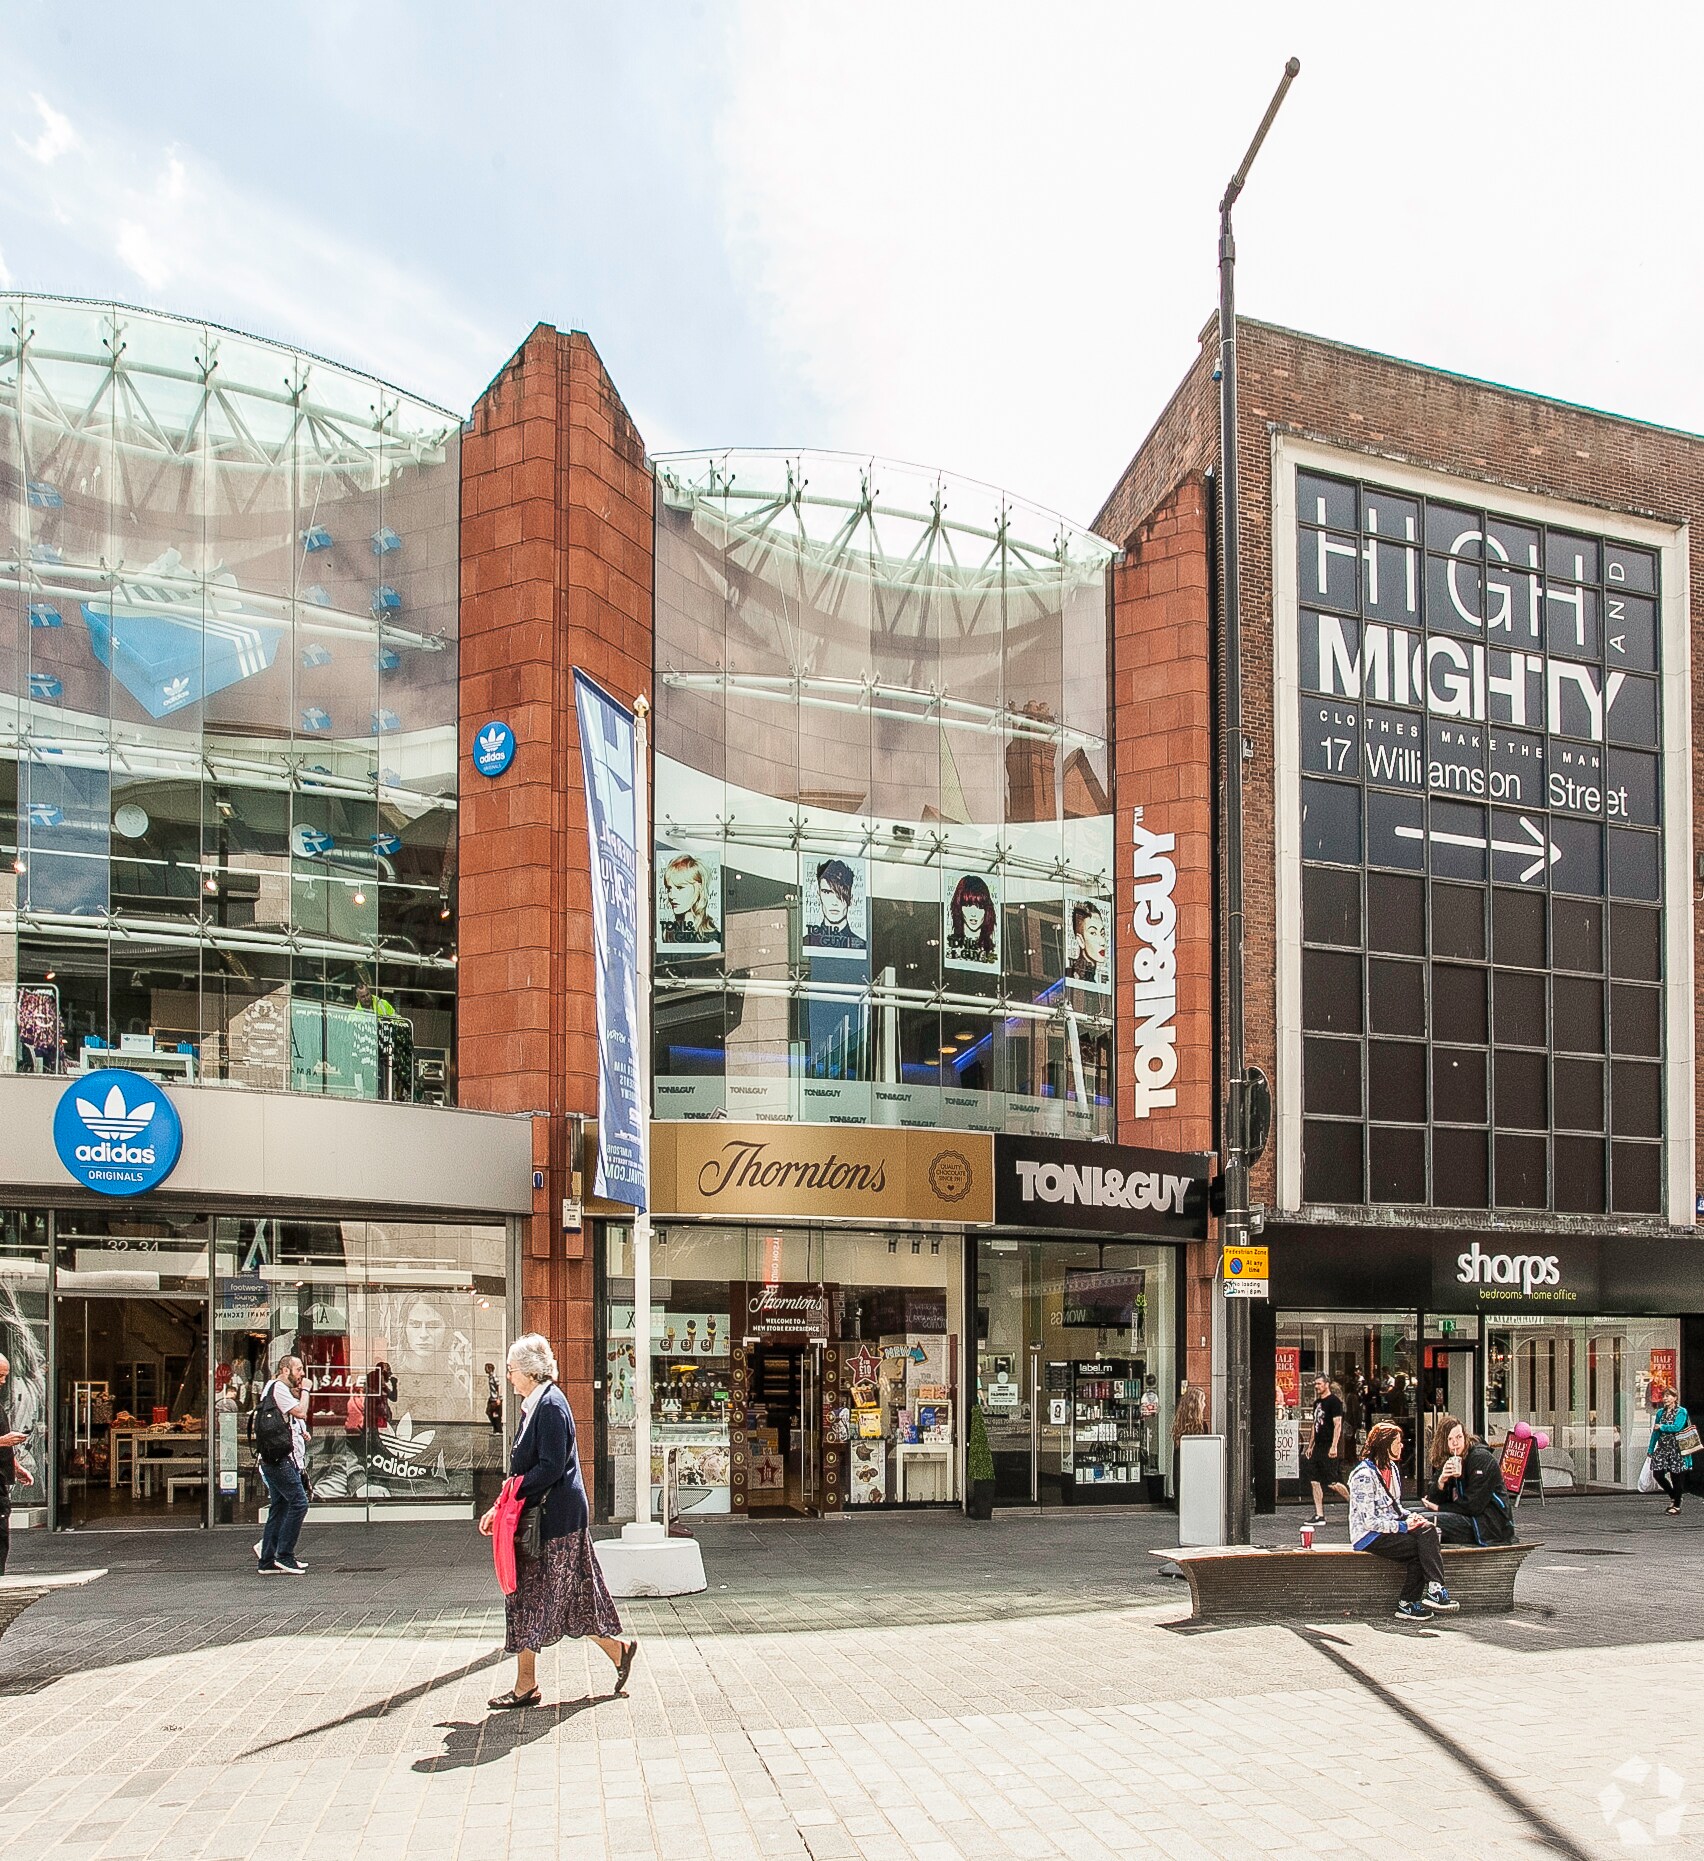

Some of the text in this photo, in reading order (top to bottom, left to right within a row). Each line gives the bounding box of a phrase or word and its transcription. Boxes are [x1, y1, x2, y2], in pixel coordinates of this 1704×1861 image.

[1317, 496, 1585, 646] HIGH
[1609, 561, 1626, 655] AND
[1318, 615, 1627, 742] MIGHTY
[1319, 710, 1600, 769] CLOTHES MAKE THE MAN
[479, 751, 505, 765] adidas
[1320, 736, 1628, 817] 17 Williamson Street
[1133, 824, 1177, 1118] TONI&GUY
[658, 1086, 696, 1094] TONI&GUY
[730, 1086, 768, 1095] TONI&GUY
[804, 1088, 841, 1098] TONI&GUY
[875, 1092, 912, 1102] TONI&GUY
[945, 1096, 979, 1108] TONI&GUY
[1009, 1103, 1041, 1114] TONI&GUY
[756, 1113, 794, 1122] TONI&GUY
[75, 1142, 155, 1164] adidas
[699, 1140, 886, 1196] Thorntons
[88, 1170, 144, 1182] ORIGINALS
[1016, 1160, 1194, 1214] TONI&GUY
[108, 1240, 159, 1256] 32-34
[1457, 1242, 1560, 1294] sharps
[1479, 1288, 1523, 1300] bedrooms
[1553, 1289, 1577, 1300] office
[748, 1290, 822, 1313] Thorntons
[784, 1325, 820, 1333] EXPERIENCE
[885, 1346, 912, 1360] NEW
[1653, 1355, 1673, 1363] HALF
[859, 1356, 864, 1366] 2
[1079, 1358, 1113, 1367] label.m
[859, 1365, 872, 1375] £10
[321, 1374, 367, 1388] SALE
[1508, 1440, 1528, 1450] HALF
[1505, 1449, 1526, 1459] PRICE
[372, 1453, 427, 1478] adidas
[1502, 1461, 1522, 1477] SALE
